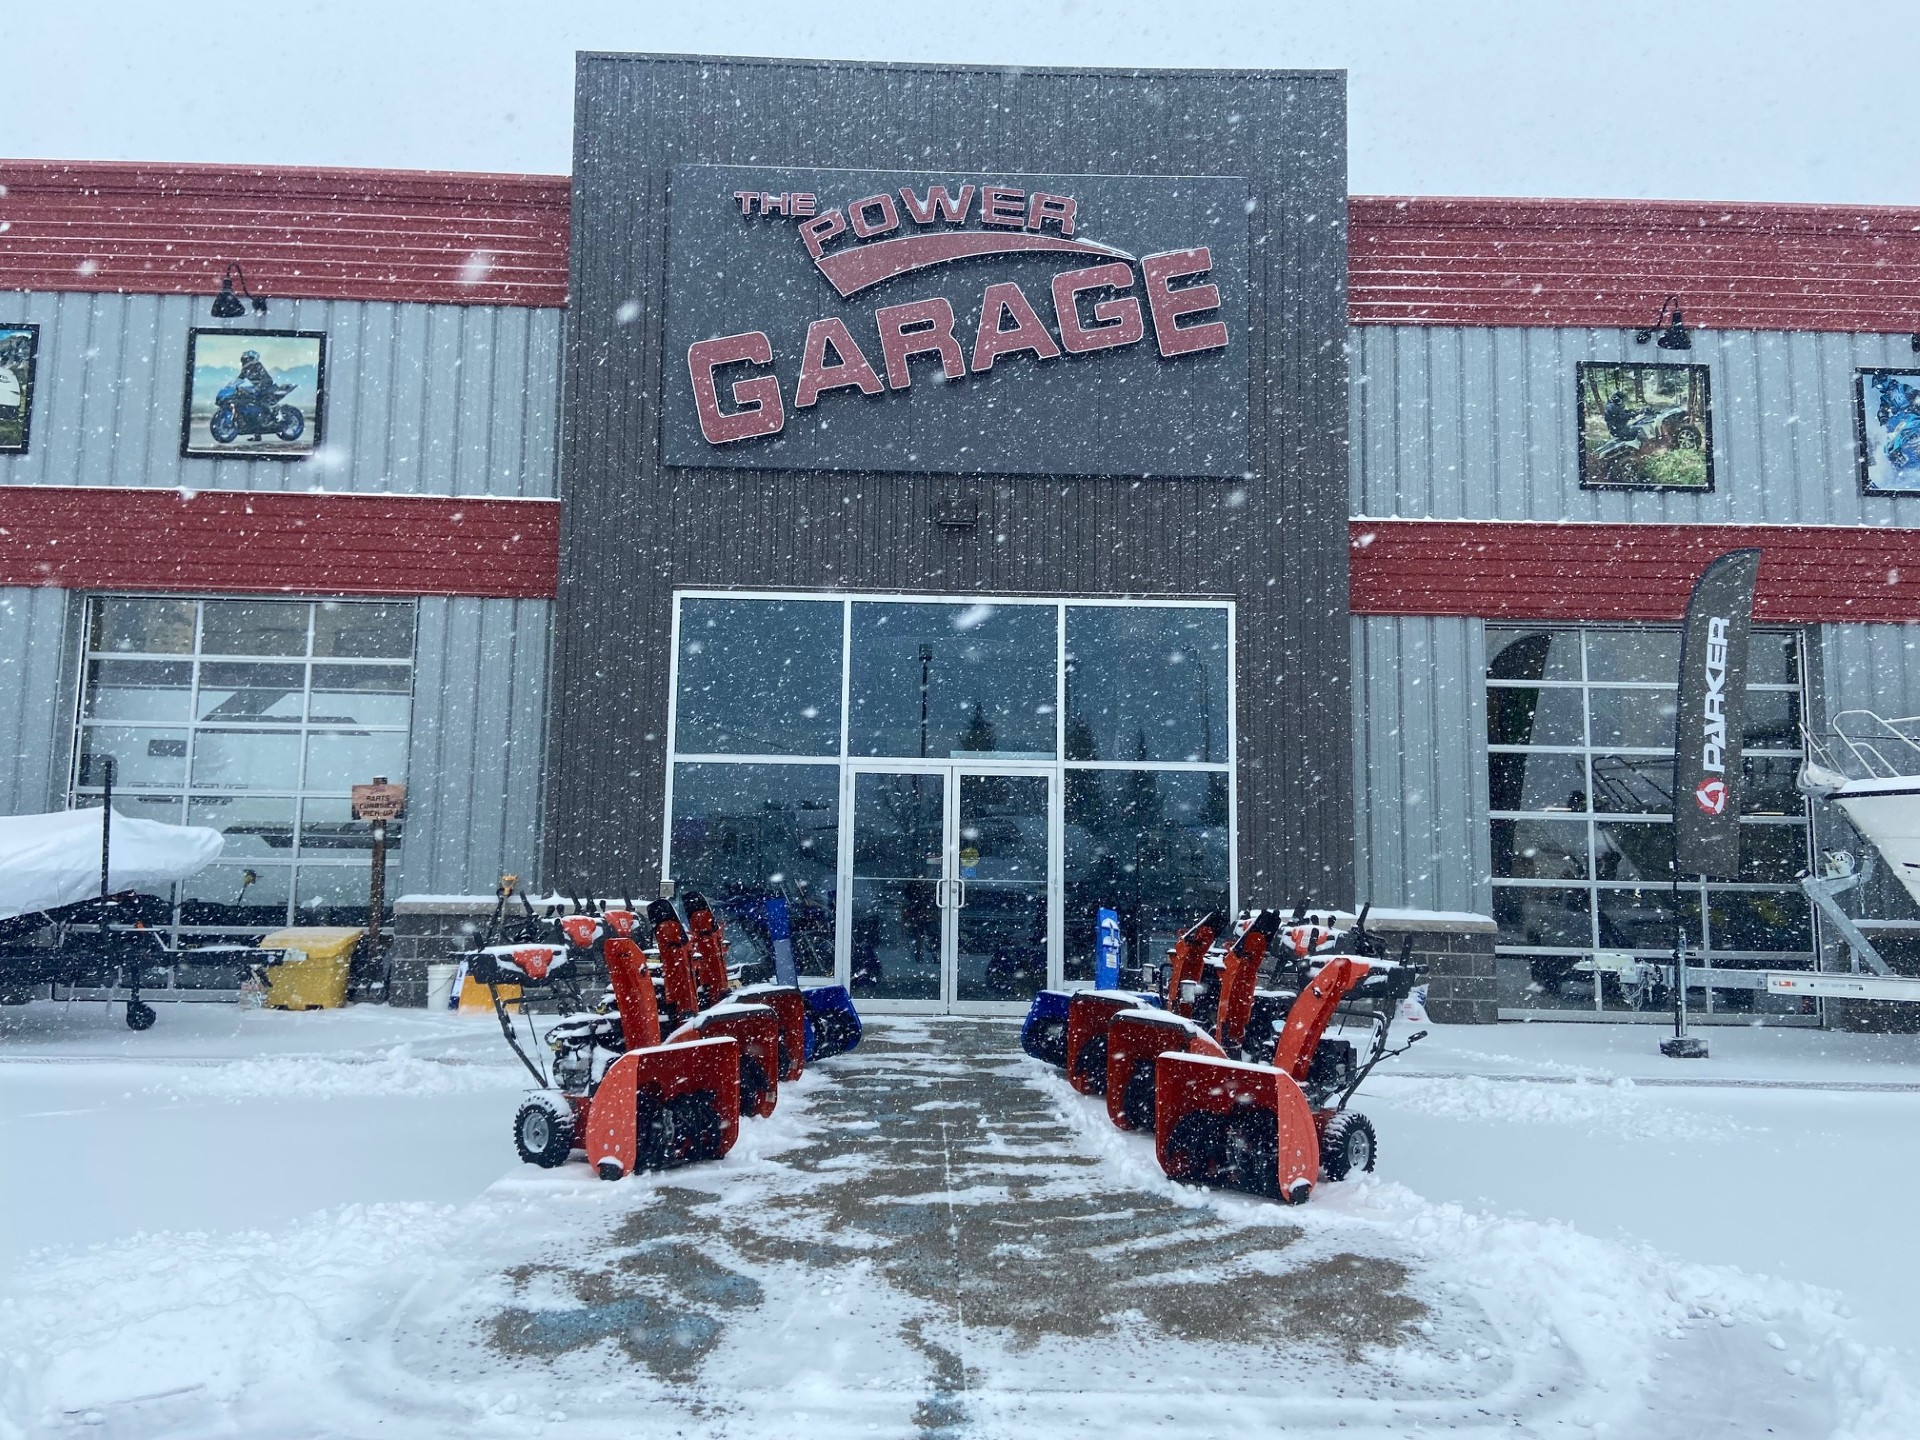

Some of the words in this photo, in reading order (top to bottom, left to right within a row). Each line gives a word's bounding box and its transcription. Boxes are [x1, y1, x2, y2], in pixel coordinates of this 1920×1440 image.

[734, 191, 816, 216] THE
[799, 185, 1077, 258] POWER
[688, 246, 1229, 444] GARAGE
[1703, 616, 1730, 774] PARKER
